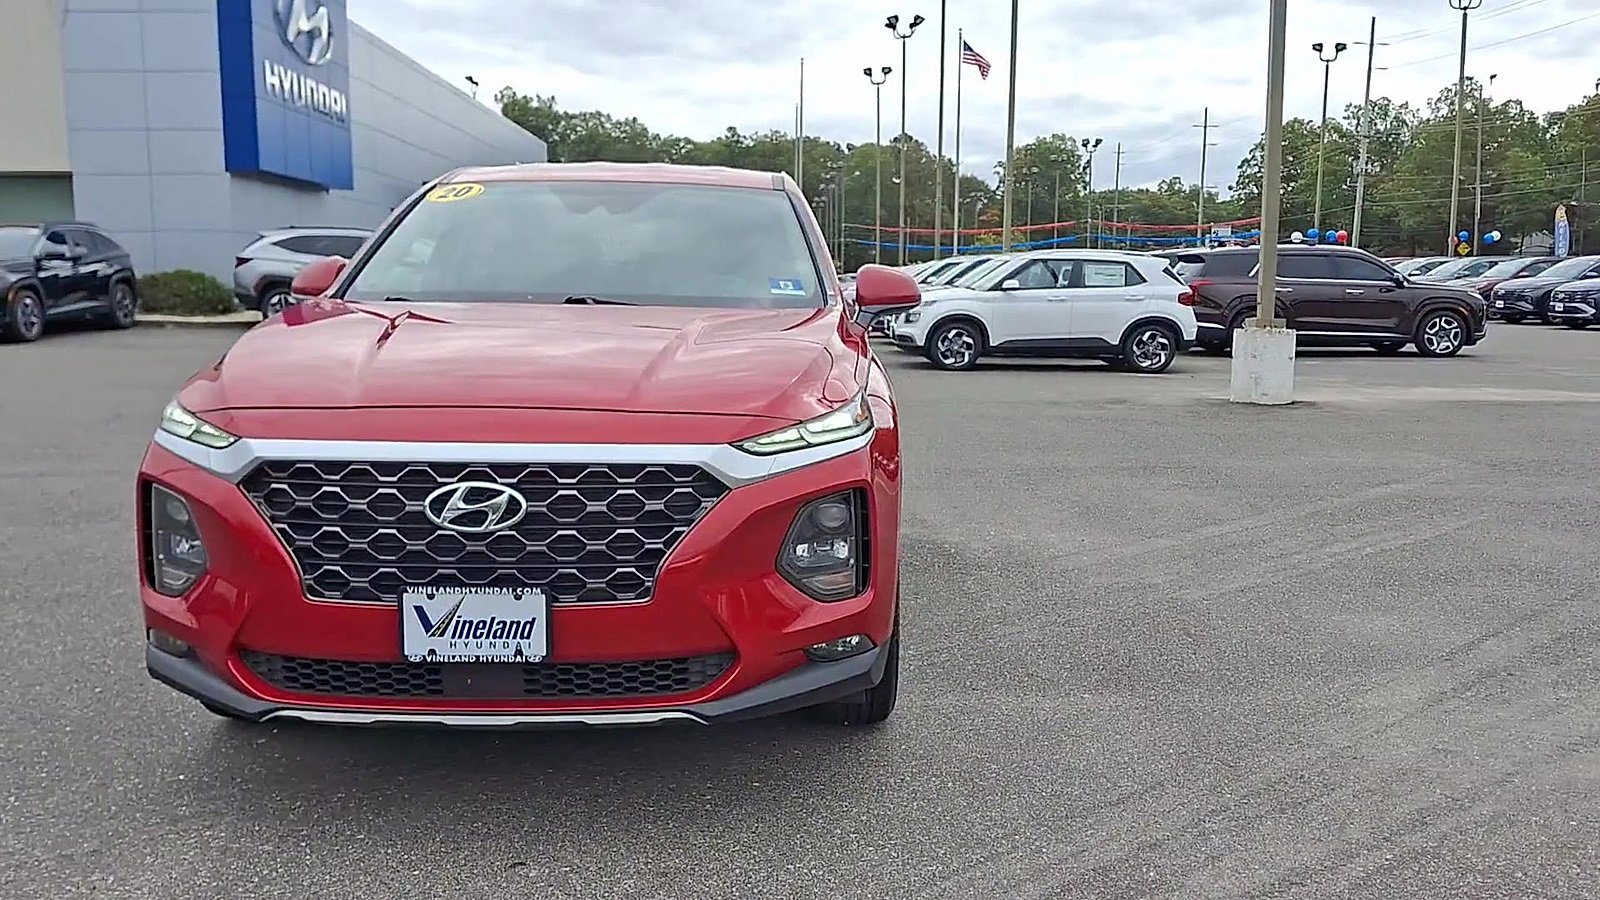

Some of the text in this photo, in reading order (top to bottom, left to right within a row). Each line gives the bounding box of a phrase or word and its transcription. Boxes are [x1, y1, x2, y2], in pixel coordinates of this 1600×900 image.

[264, 59, 347, 121] HYUNDAI
[436, 186, 474, 199] 20
[407, 586, 541, 595] VINELANDHYUNDAI.COM
[413, 594, 537, 639] Vineland
[450, 641, 532, 649] HYUNDAI
